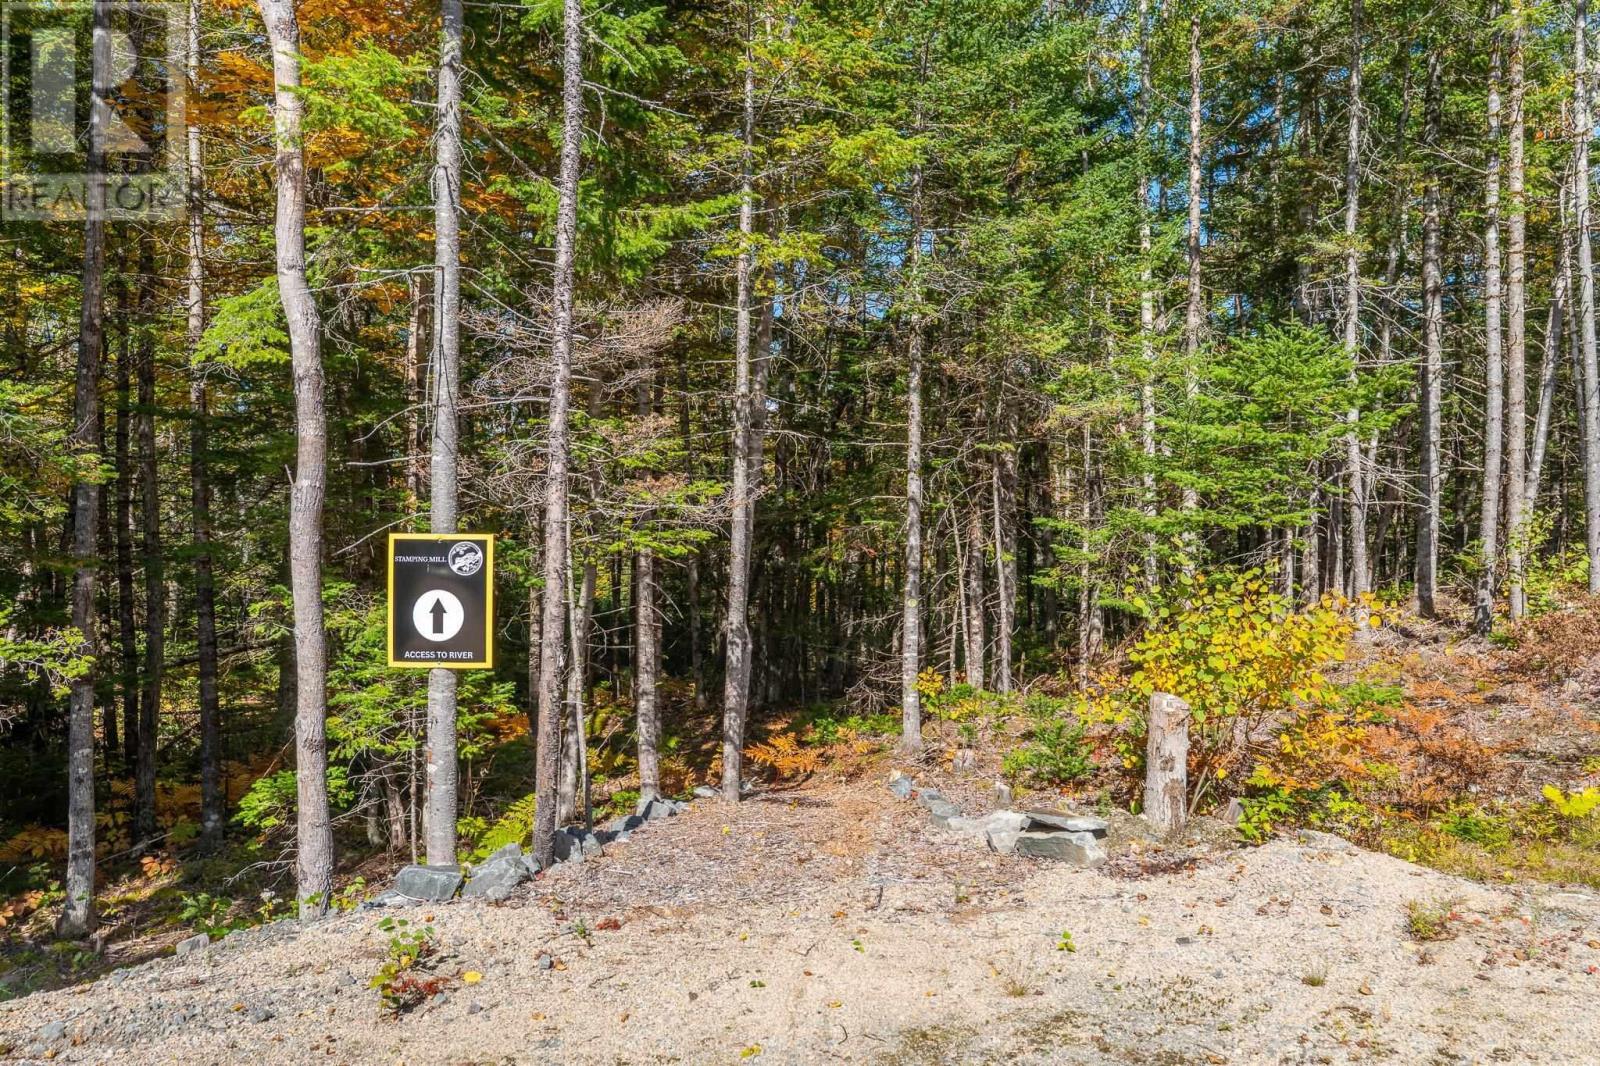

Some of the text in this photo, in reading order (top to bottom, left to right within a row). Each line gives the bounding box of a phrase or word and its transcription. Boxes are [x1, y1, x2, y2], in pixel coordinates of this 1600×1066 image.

[394, 555, 428, 563] STAMPING
[404, 651, 473, 659] ACCESS TO RIVER
